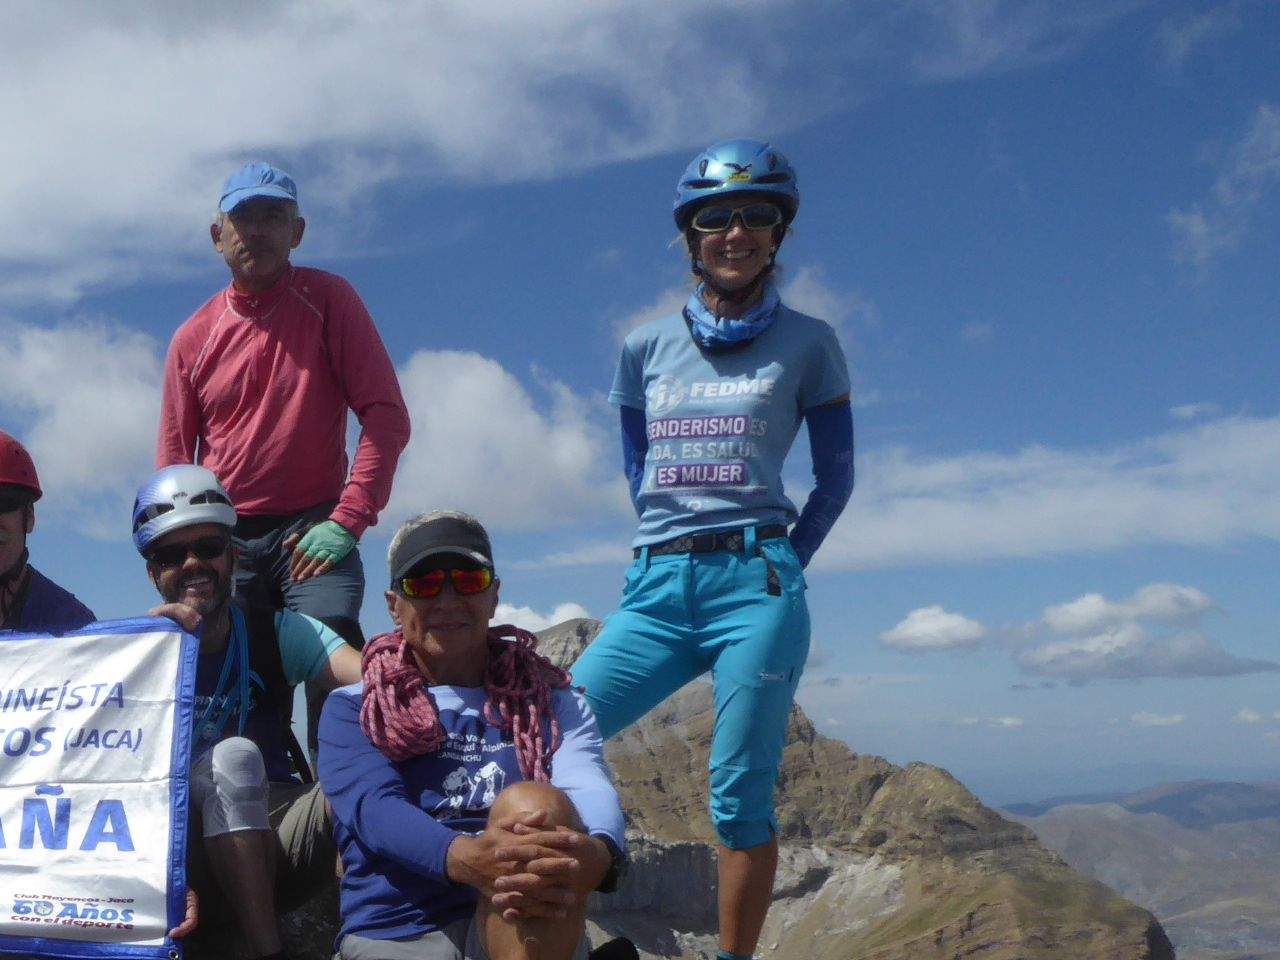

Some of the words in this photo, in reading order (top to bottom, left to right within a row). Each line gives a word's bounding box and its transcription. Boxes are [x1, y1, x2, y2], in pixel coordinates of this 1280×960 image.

[681, 443, 703, 459] ES
[658, 467, 678, 484] ES
[681, 465, 743, 482] MUJER
[63, 728, 143, 752] (JACA)
[56, 902, 135, 922] Años
[62, 918, 135, 930] deporte
